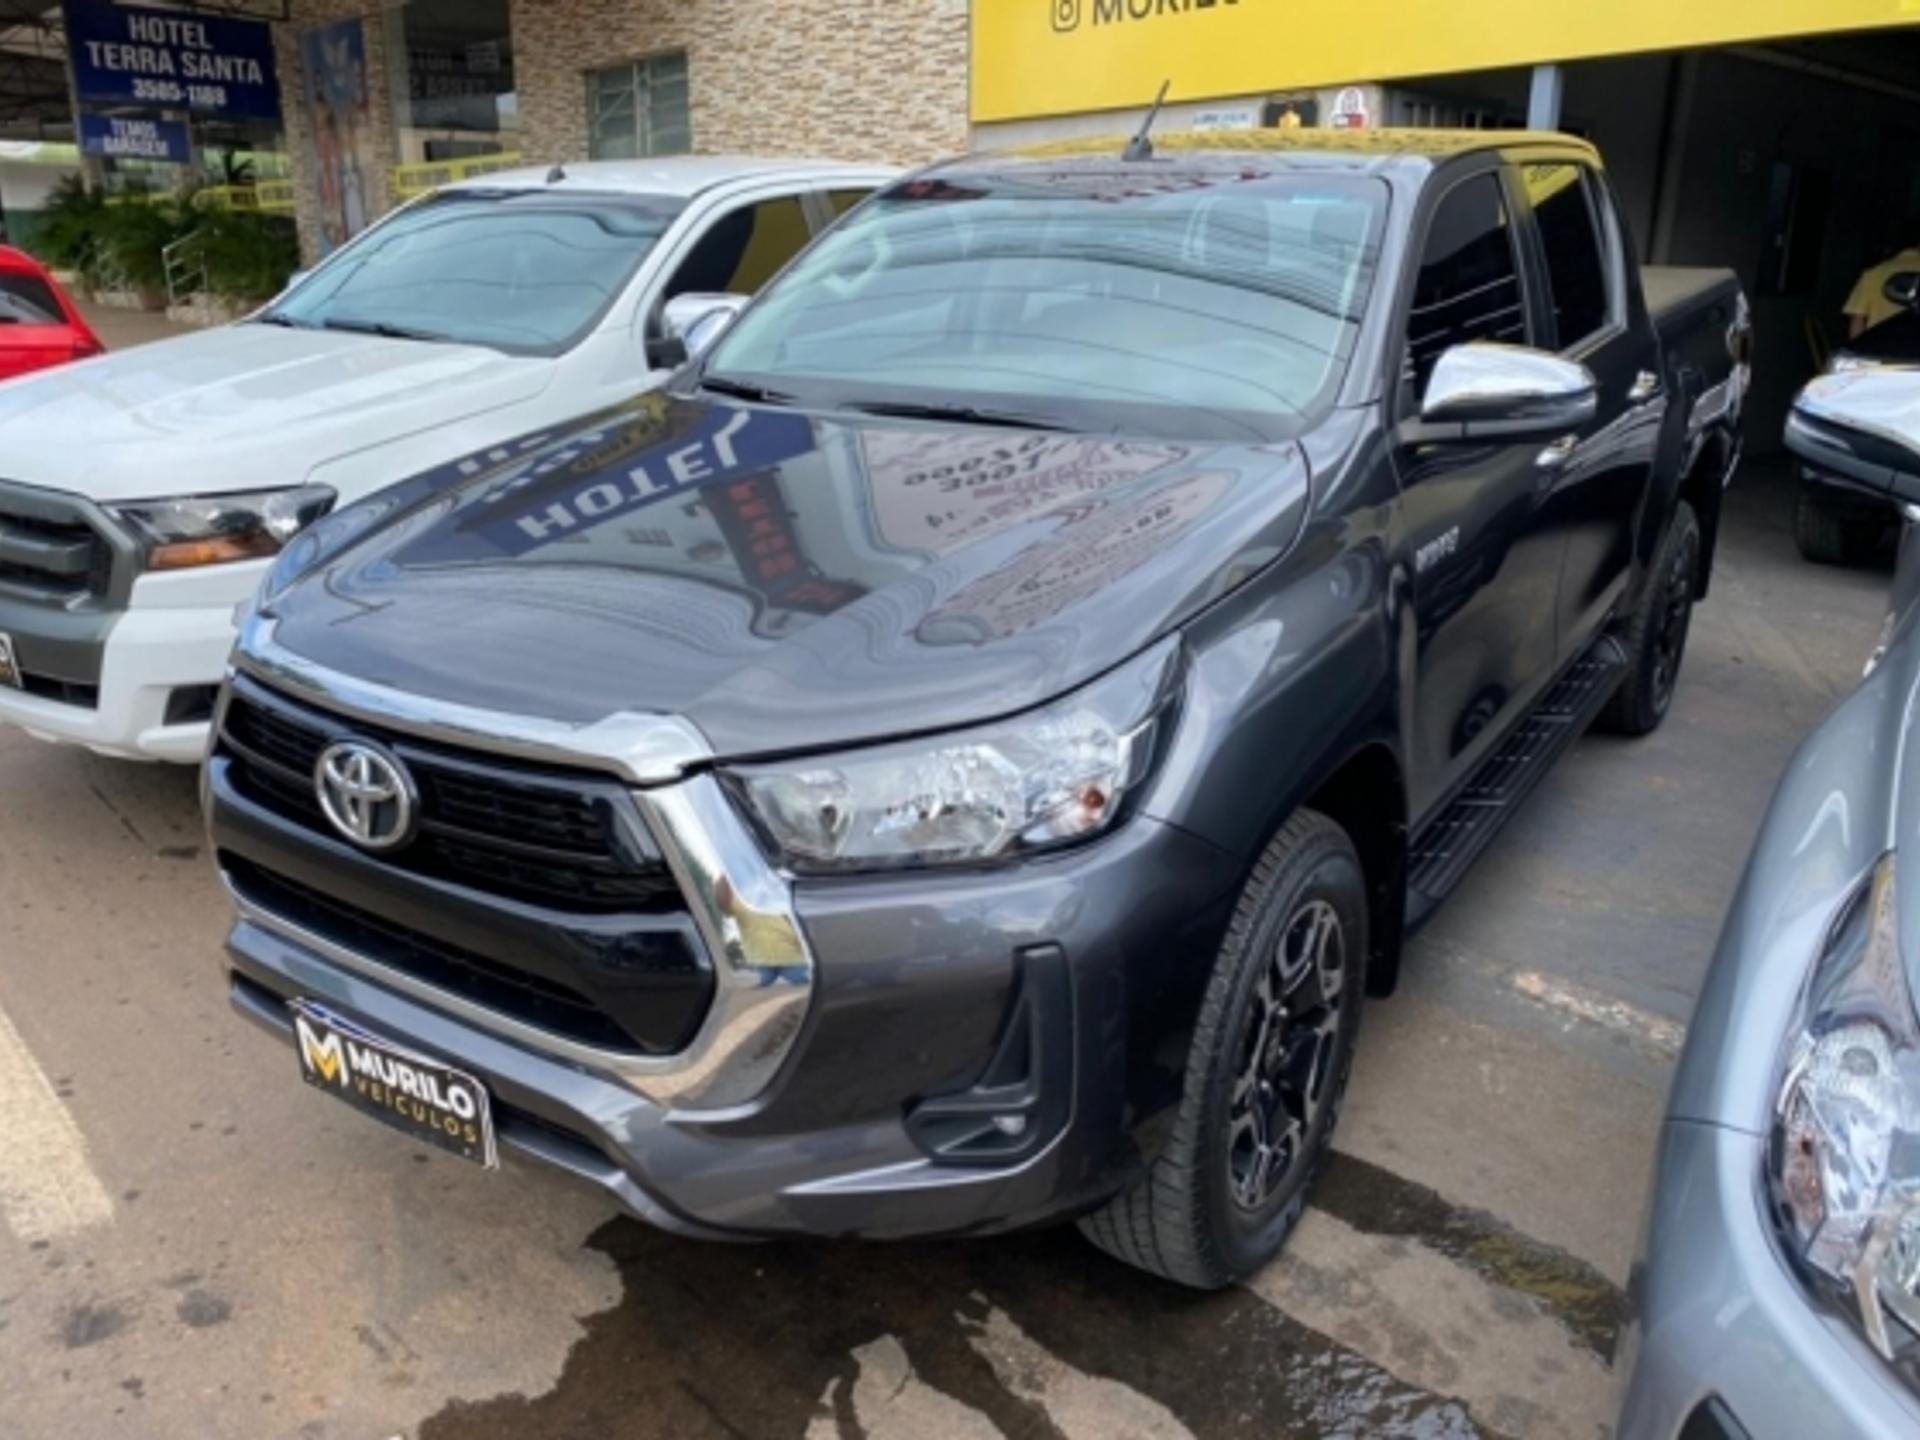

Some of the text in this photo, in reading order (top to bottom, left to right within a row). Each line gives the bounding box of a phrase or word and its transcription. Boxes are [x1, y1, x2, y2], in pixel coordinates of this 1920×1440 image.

[127, 13, 214, 50] HOTEL
[85, 40, 264, 85] TERRA SANTA
[346, 1041, 476, 1120] MURILO
